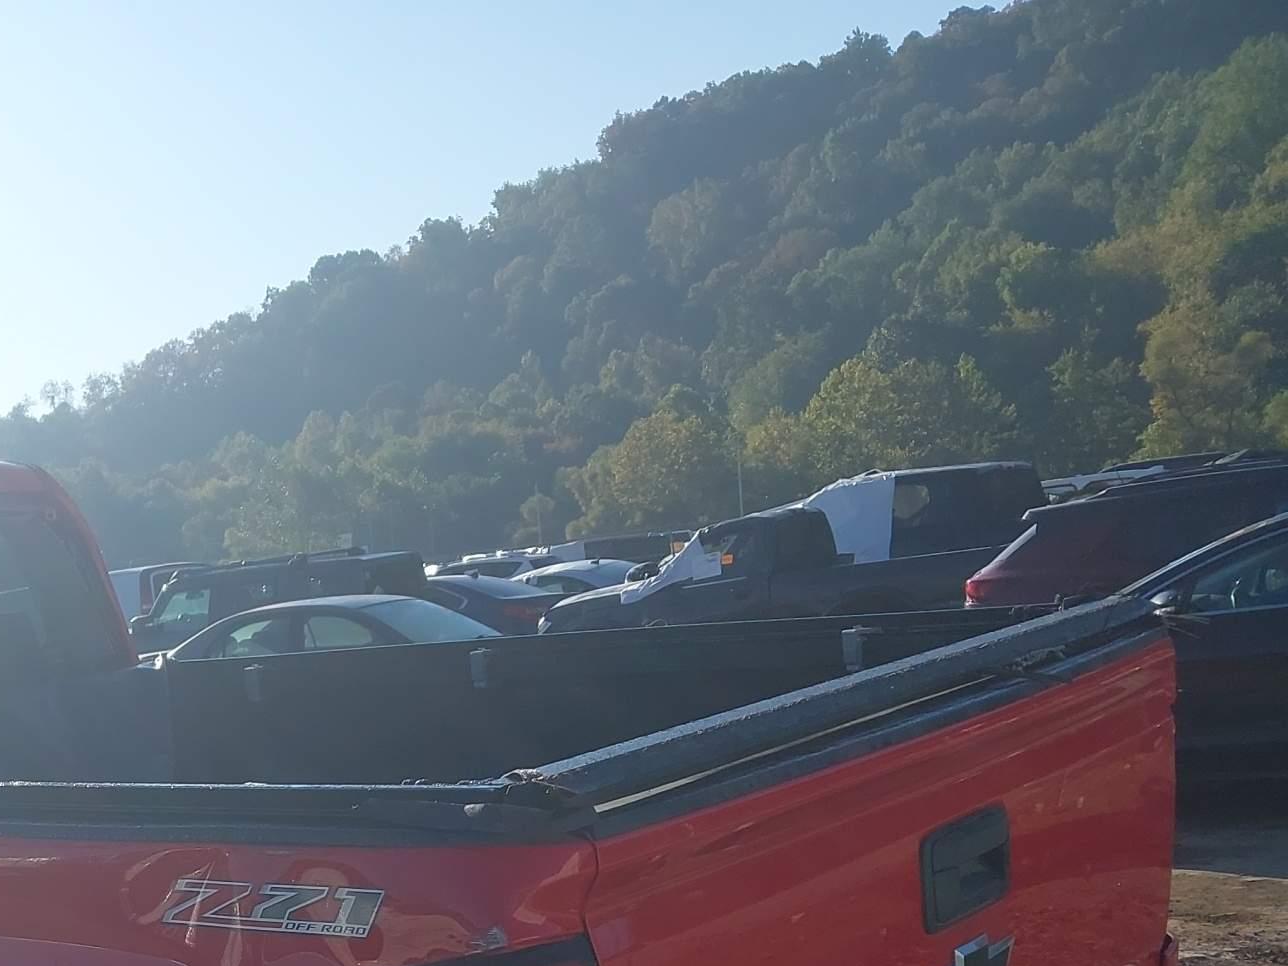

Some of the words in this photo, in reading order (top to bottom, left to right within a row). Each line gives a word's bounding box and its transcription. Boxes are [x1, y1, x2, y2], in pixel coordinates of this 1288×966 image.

[162, 878, 385, 932] Z71
[284, 921, 318, 932] OFF
[320, 923, 368, 936] ROAD
